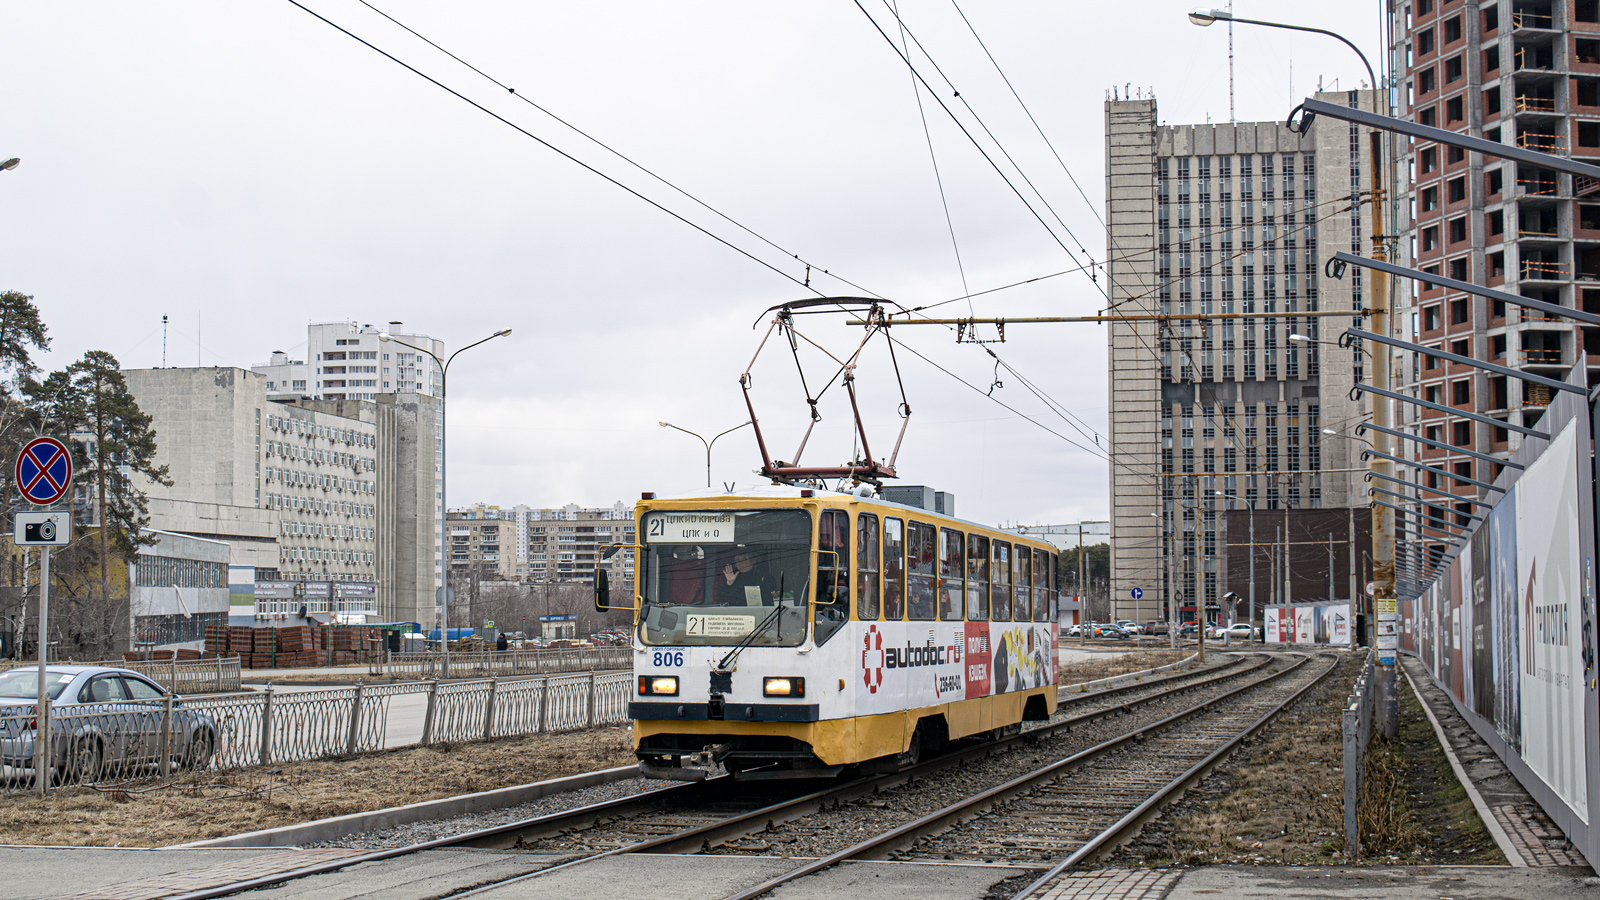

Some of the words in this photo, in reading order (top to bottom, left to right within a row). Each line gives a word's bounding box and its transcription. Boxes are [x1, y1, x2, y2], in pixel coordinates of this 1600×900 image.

[650, 518, 665, 536] 21
[682, 529, 700, 539] ЦПК
[688, 616, 705, 635] 21
[1535, 602, 1569, 647] ТРИЛОГИЯ
[653, 651, 684, 667] 806
[886, 639, 961, 669] autodoc.ru
